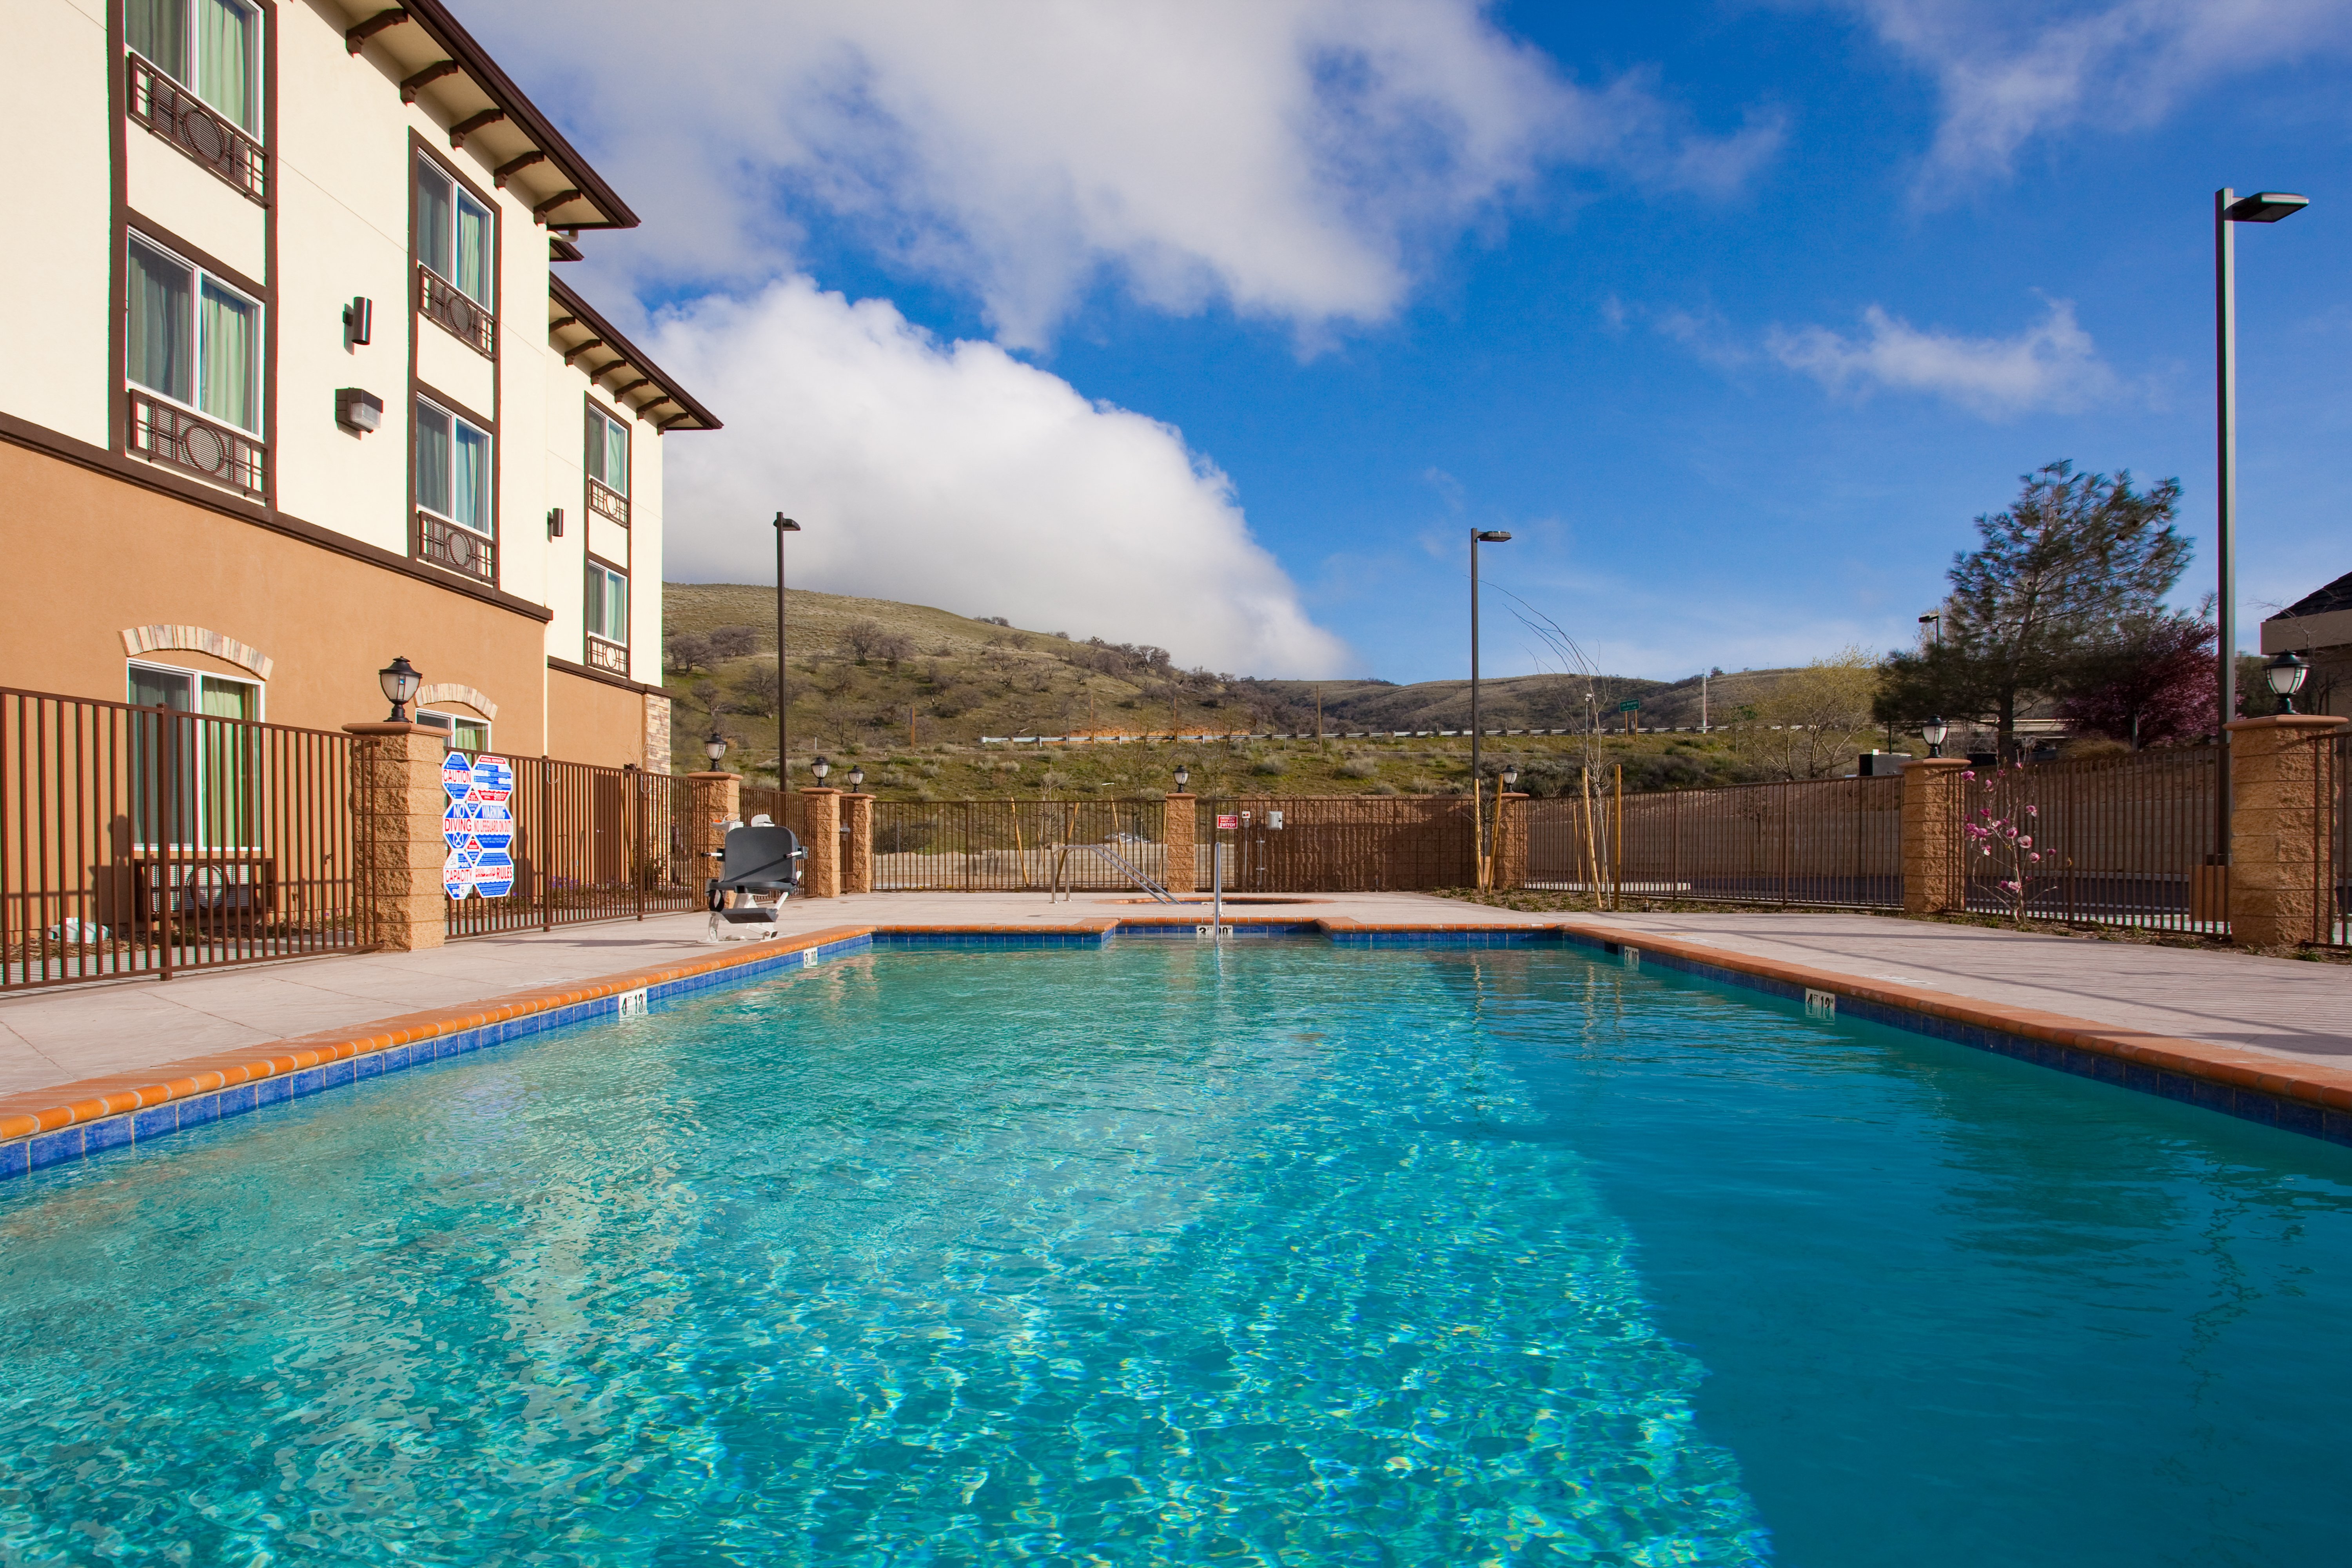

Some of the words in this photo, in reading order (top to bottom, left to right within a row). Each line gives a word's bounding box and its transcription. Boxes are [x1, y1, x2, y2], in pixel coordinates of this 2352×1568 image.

[443, 769, 471, 783] CAUTION
[454, 804, 465, 818] NO
[482, 806, 505, 819] WARNING
[445, 818, 472, 832] DIVING
[474, 820, 479, 832] NO
[480, 820, 498, 832] LIFEGUARD
[499, 820, 504, 832] ON
[446, 869, 472, 882] CAPACITY
[497, 867, 512, 879] RULES
